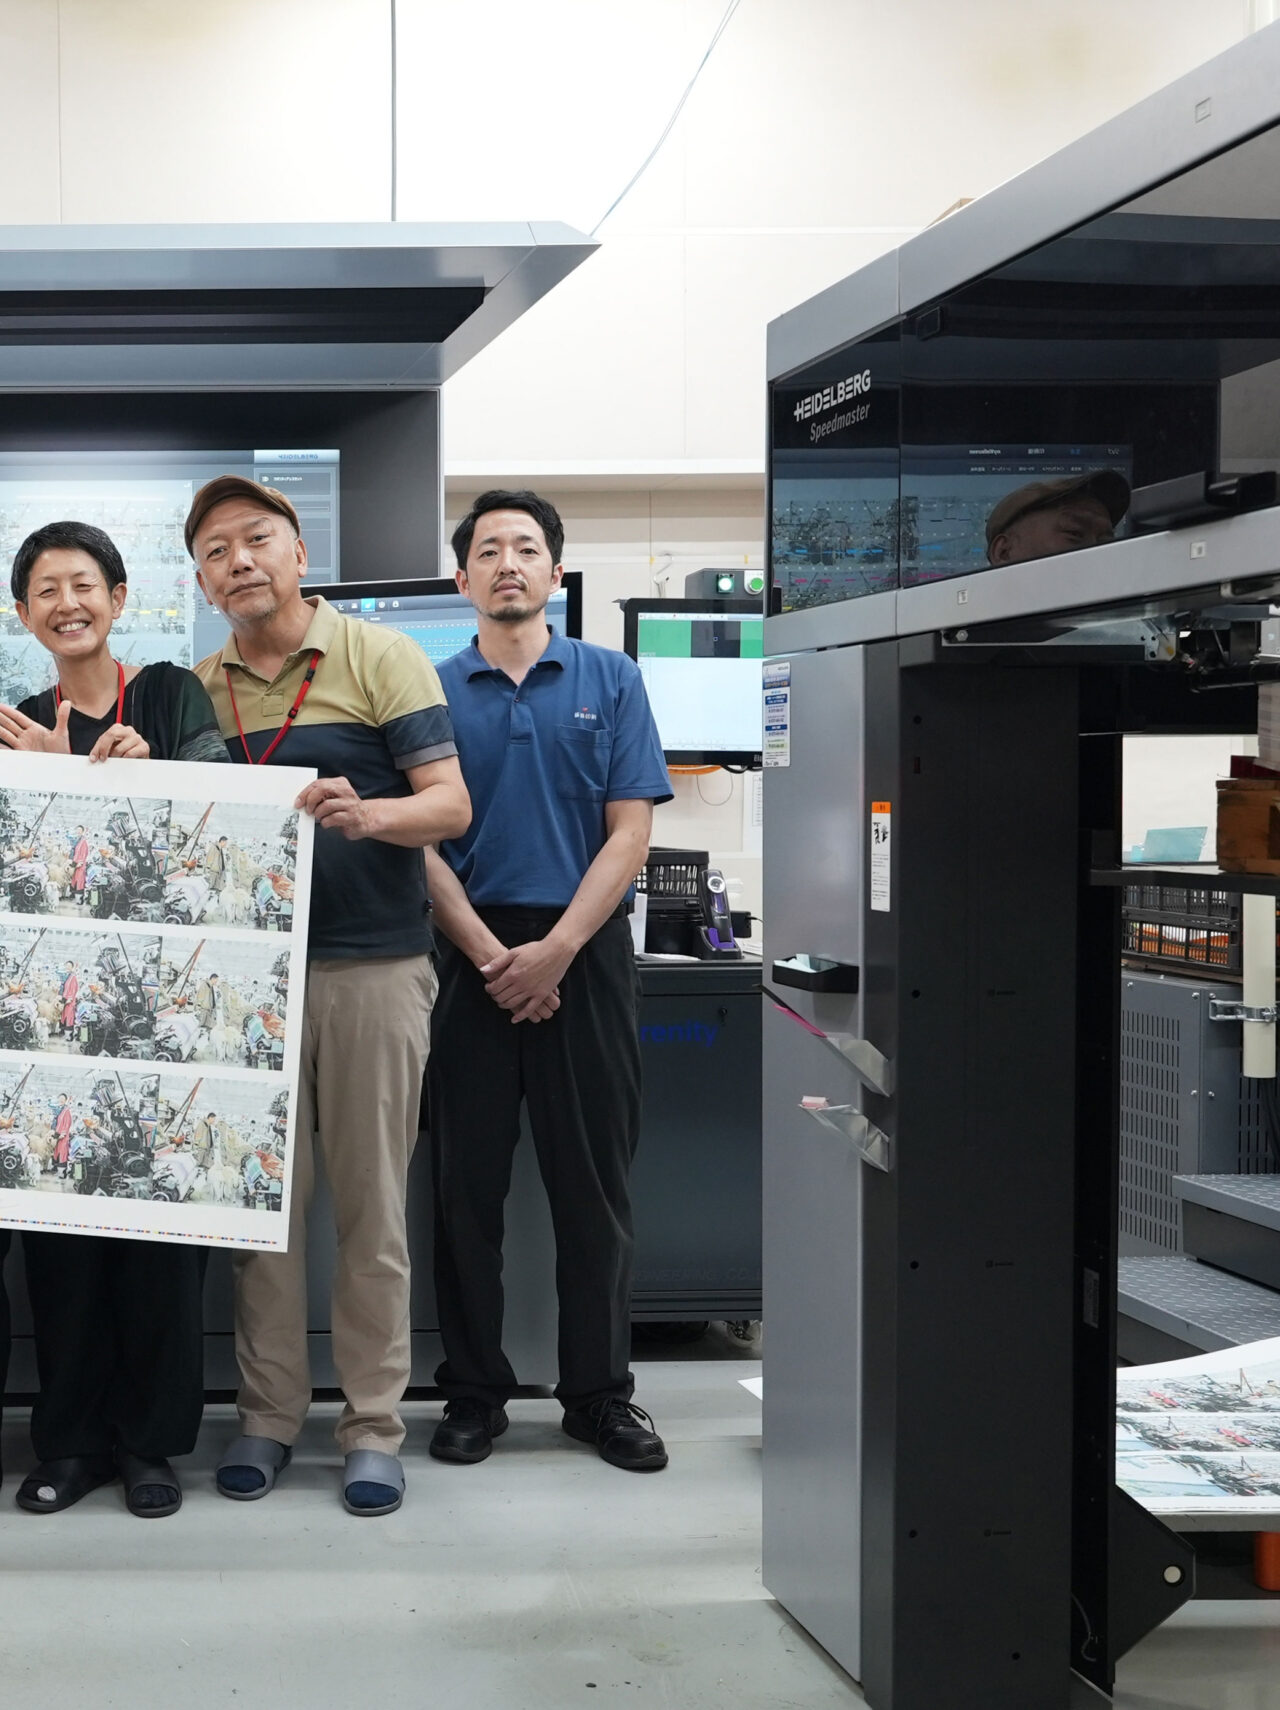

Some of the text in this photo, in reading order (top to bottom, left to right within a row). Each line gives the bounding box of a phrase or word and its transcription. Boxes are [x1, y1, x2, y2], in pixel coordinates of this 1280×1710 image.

[793, 369, 871, 422] HEIDELBERG
[809, 403, 871, 443] Speedmaster
[641, 1019, 719, 1047] renity
